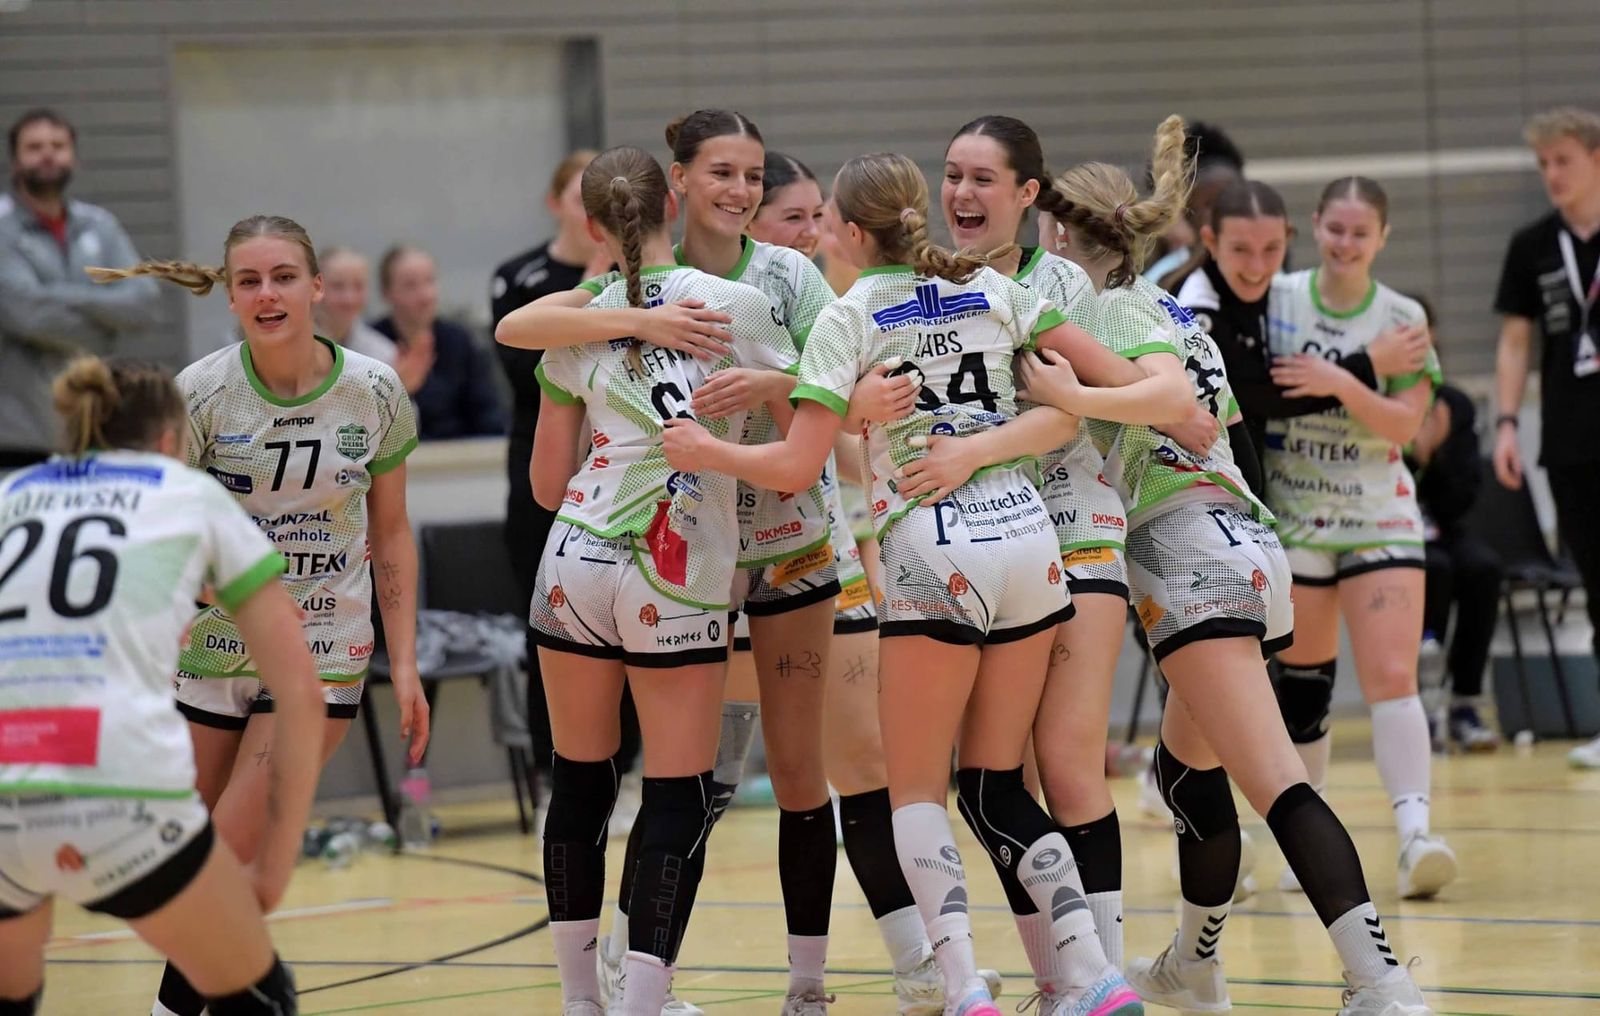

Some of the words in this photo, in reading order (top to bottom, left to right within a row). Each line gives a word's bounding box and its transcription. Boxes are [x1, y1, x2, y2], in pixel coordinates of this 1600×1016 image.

[915, 330, 963, 357] LABS
[273, 416, 314, 428] Kempa
[265, 440, 322, 492] 77
[1092, 513, 1116, 526] DKMS
[267, 528, 332, 543] Reinholz
[755, 523, 790, 541] DKMS
[0, 514, 127, 620] 26
[657, 631, 702, 647] HERMES
